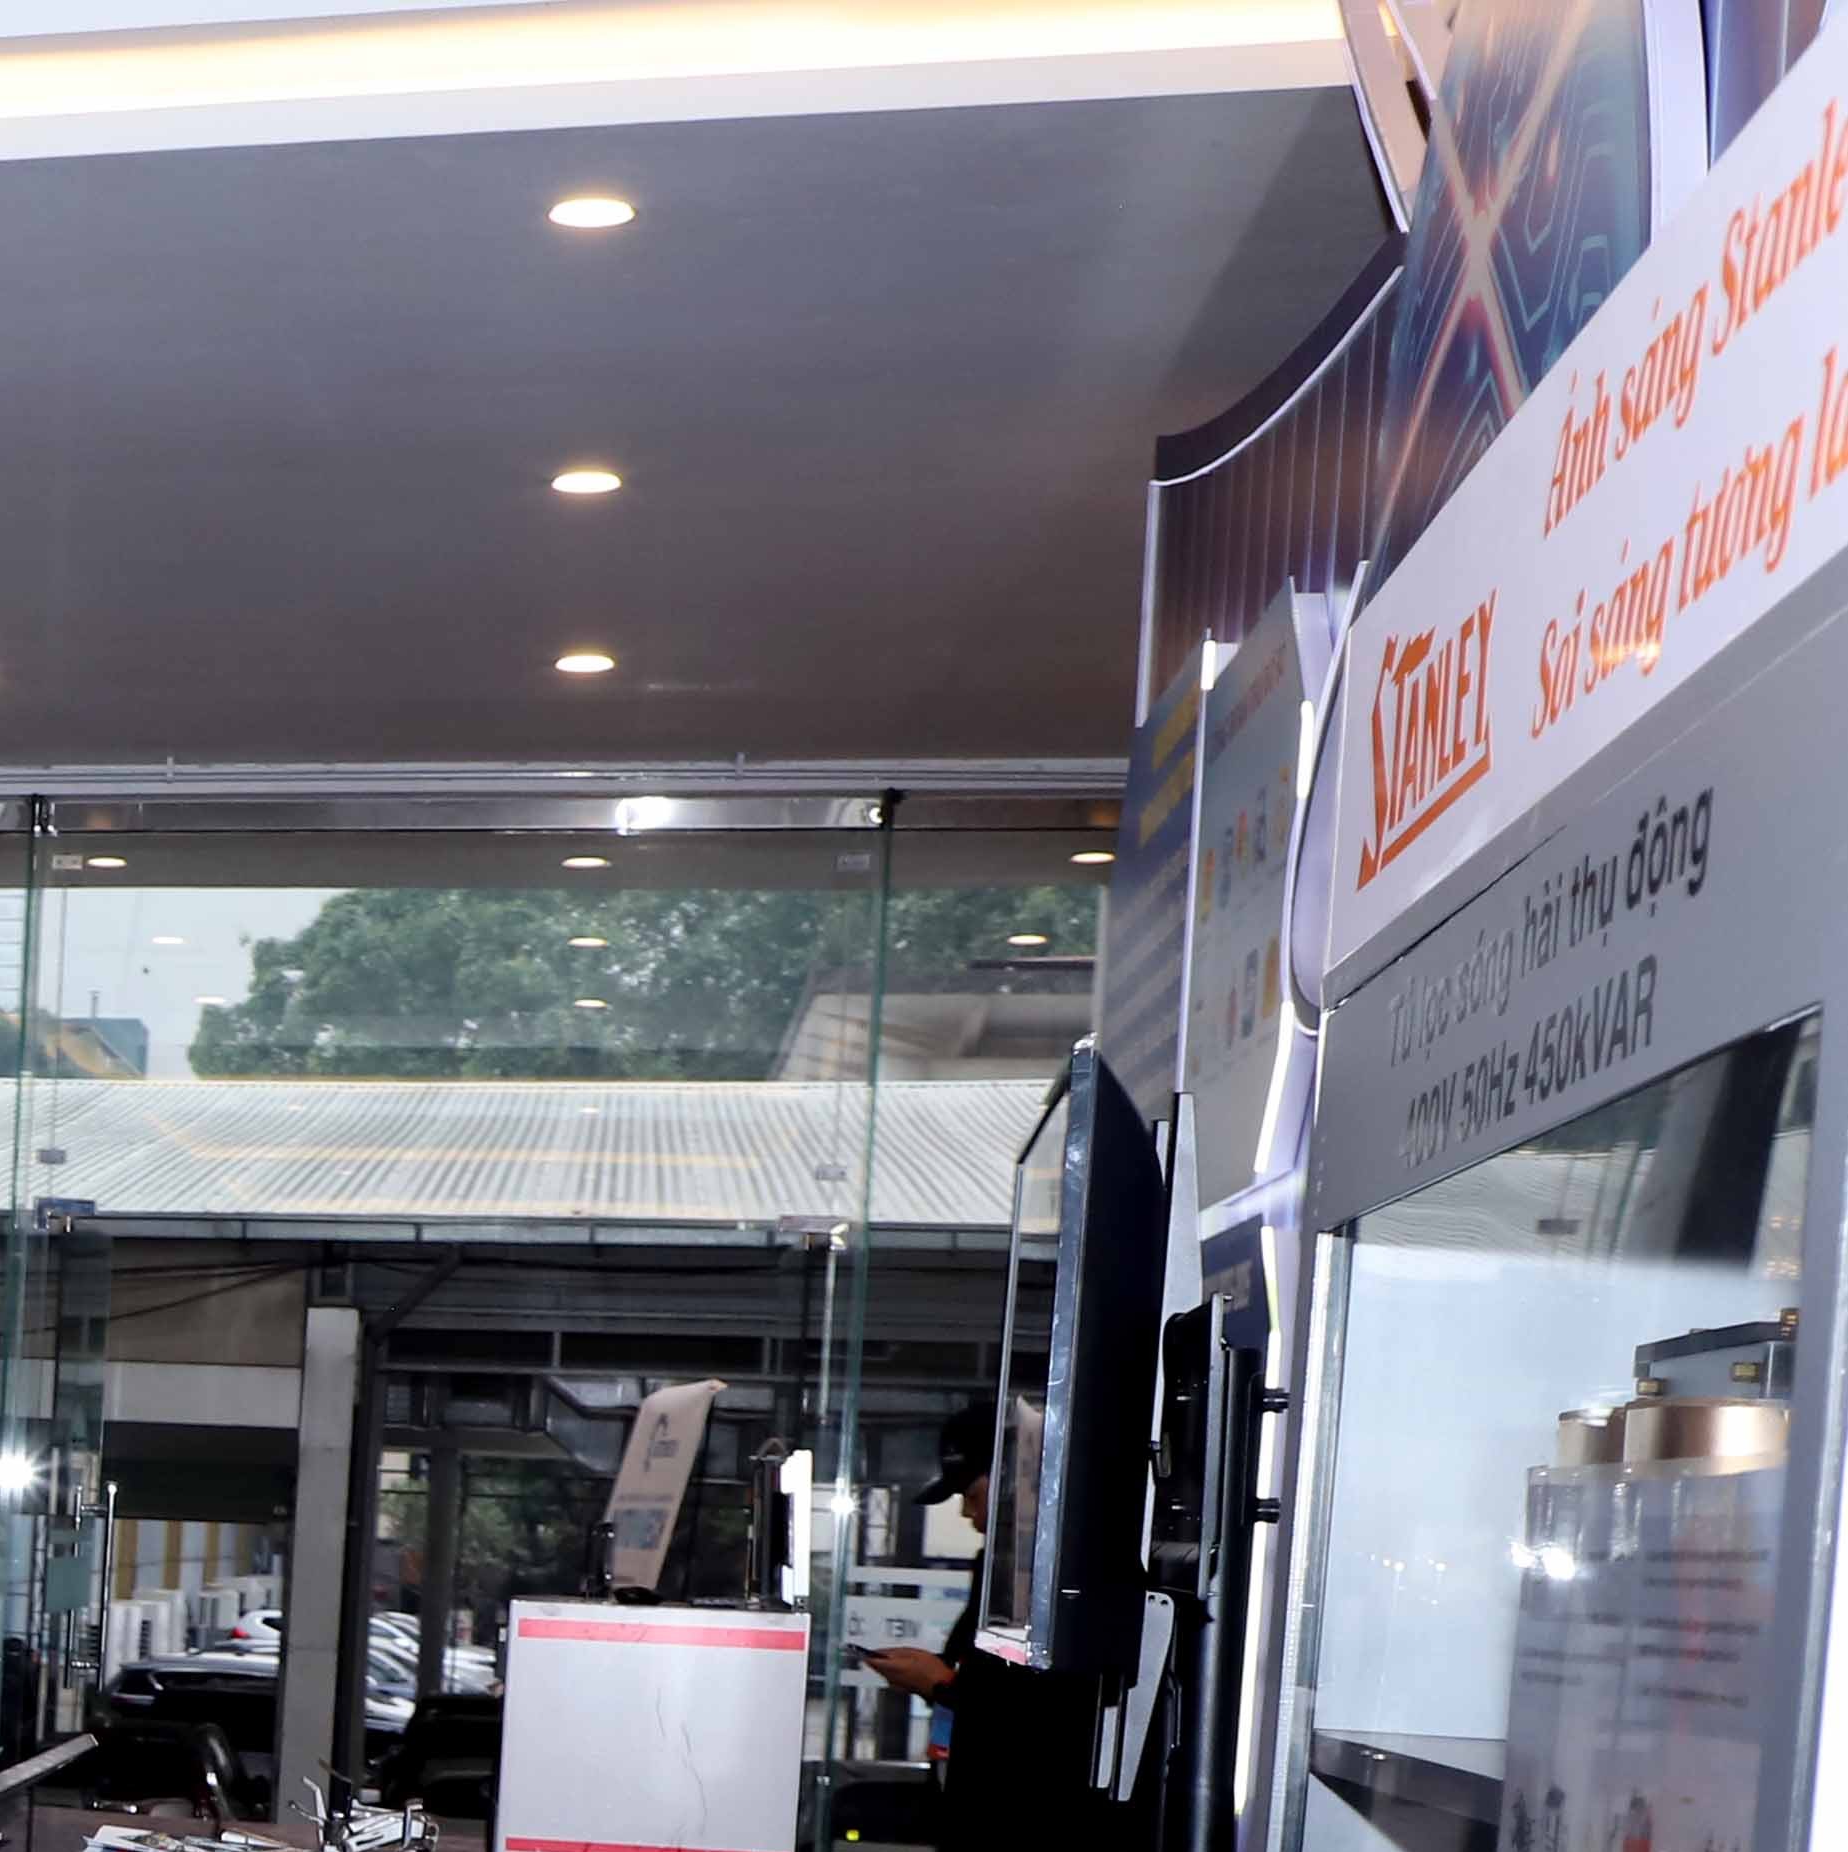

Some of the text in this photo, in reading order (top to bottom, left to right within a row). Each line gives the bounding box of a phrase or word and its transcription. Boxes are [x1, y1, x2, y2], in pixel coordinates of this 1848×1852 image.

[1544, 96, 1848, 541] Ánh sáng Stanle
[1532, 343, 1848, 740] Soi sáng tương la
[1454, 926, 1515, 1025] sóng
[1569, 851, 1619, 948] thụ
[1626, 785, 1715, 918] động
[1459, 1039, 1521, 1143] 50Hz
[1522, 953, 1658, 1106] 450kVAR
